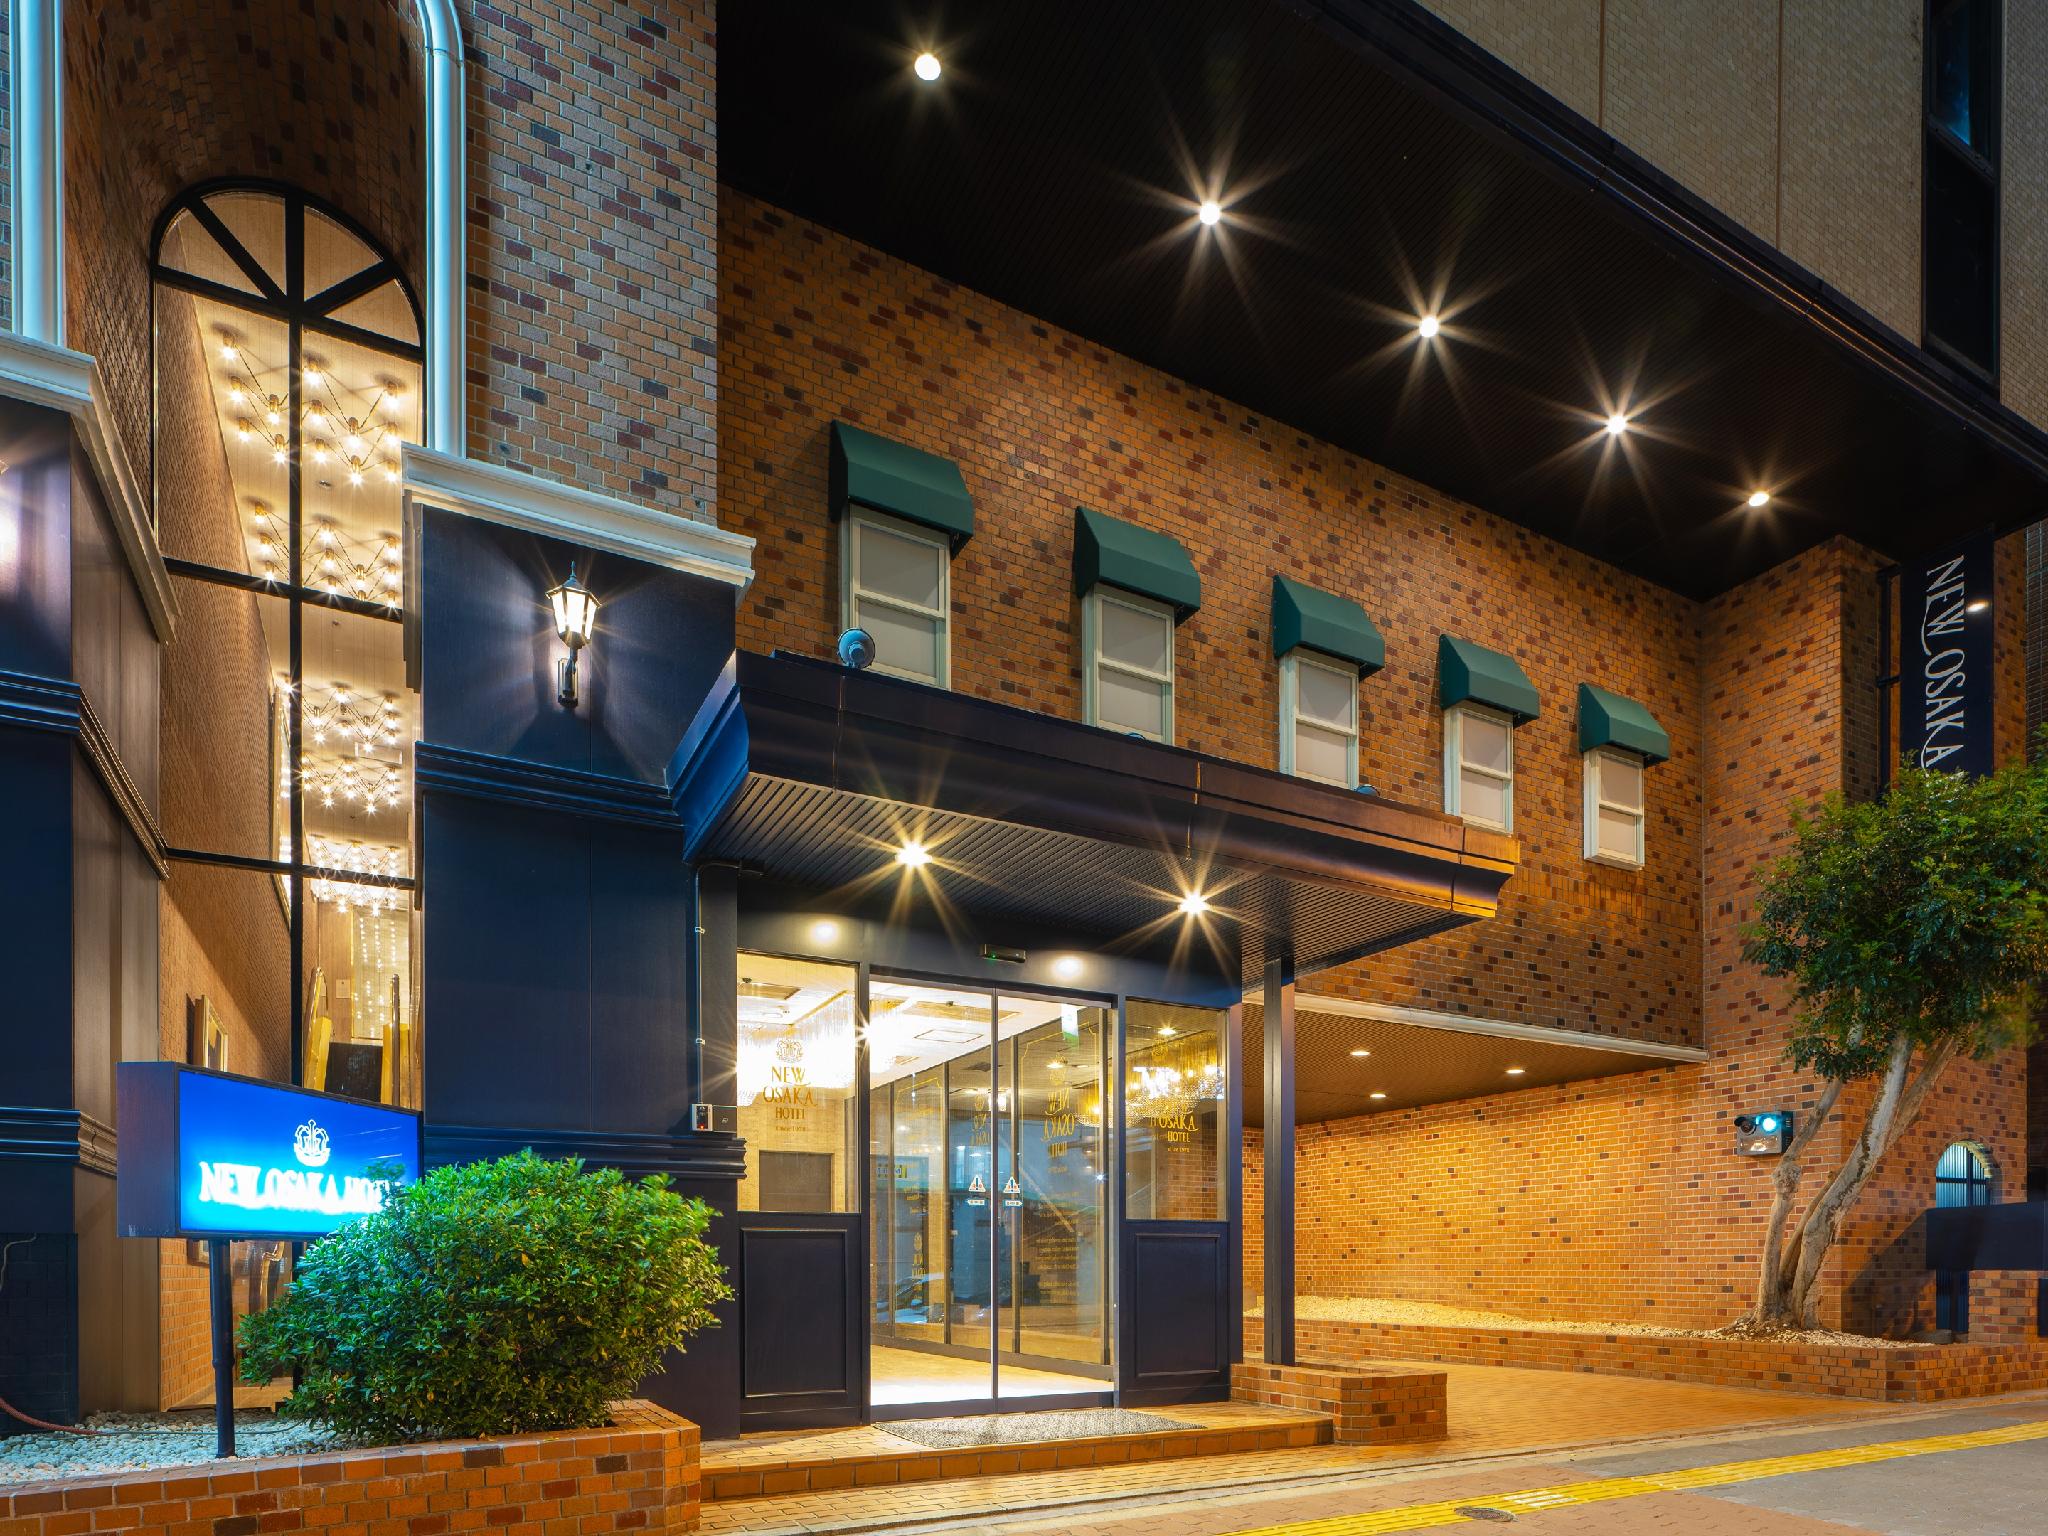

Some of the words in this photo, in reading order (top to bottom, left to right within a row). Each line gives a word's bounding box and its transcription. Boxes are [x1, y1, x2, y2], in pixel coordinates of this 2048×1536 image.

[1921, 554, 1965, 656] NEW
[1921, 648, 1966, 769] OSAKA
[771, 1066, 811, 1087] NEW
[763, 1086, 817, 1107] OSAKA
[1167, 1131, 1190, 1142] HOTEL
